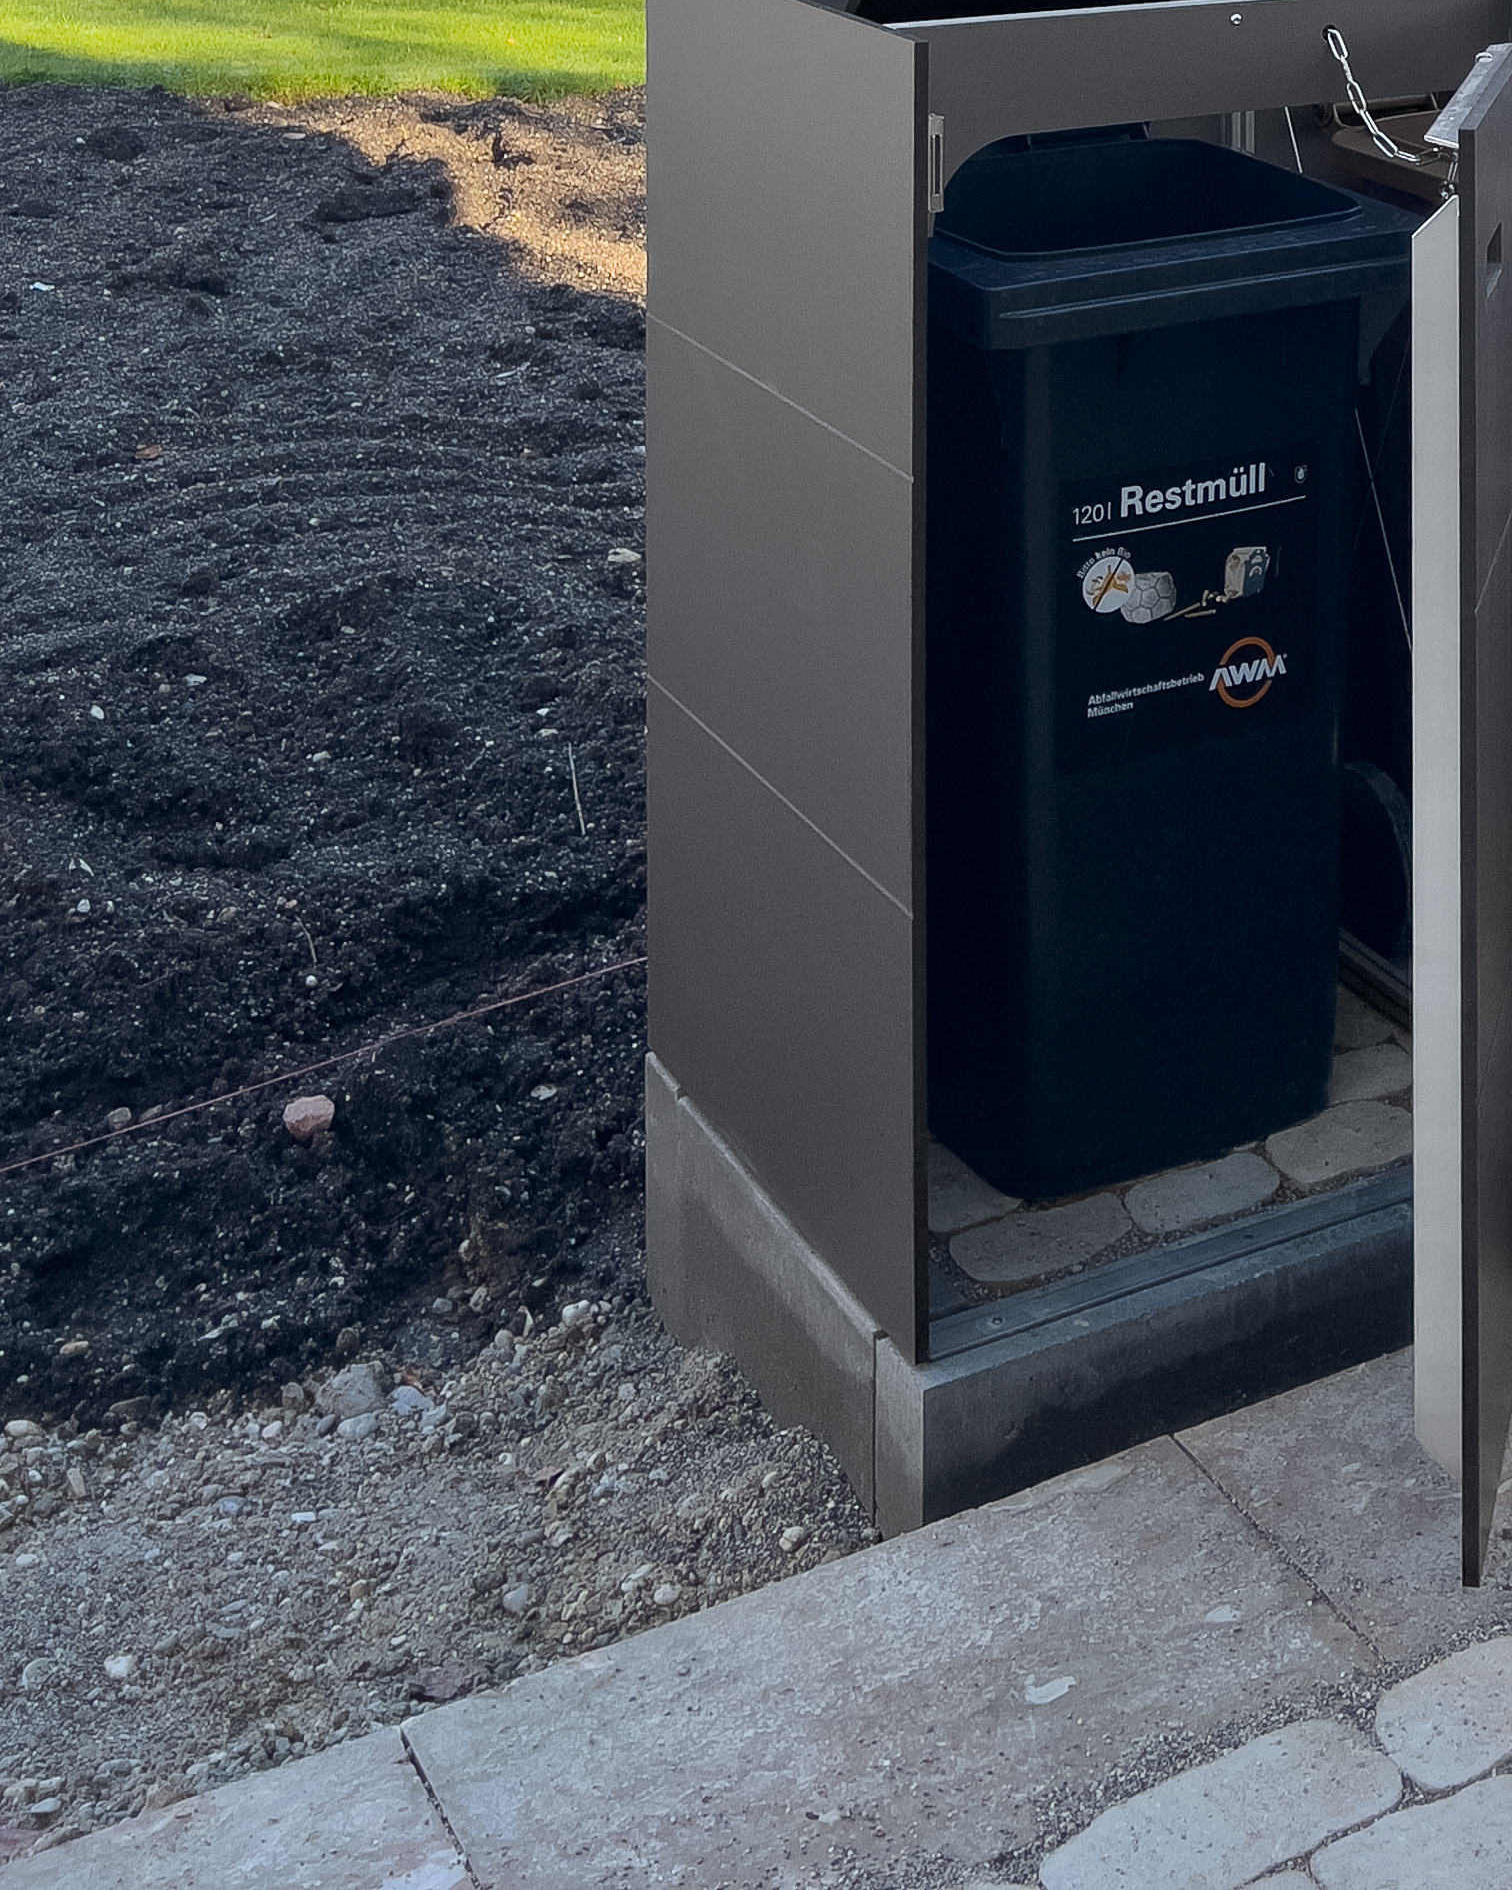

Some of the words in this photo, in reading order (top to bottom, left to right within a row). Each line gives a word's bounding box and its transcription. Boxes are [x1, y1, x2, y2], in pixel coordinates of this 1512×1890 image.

[1120, 462, 1266, 518] Restmüll
[1087, 672, 1205, 706] Abfallwirtschaftsbetrieb
[1209, 655, 1286, 691] AWM
[1087, 701, 1134, 719] München
